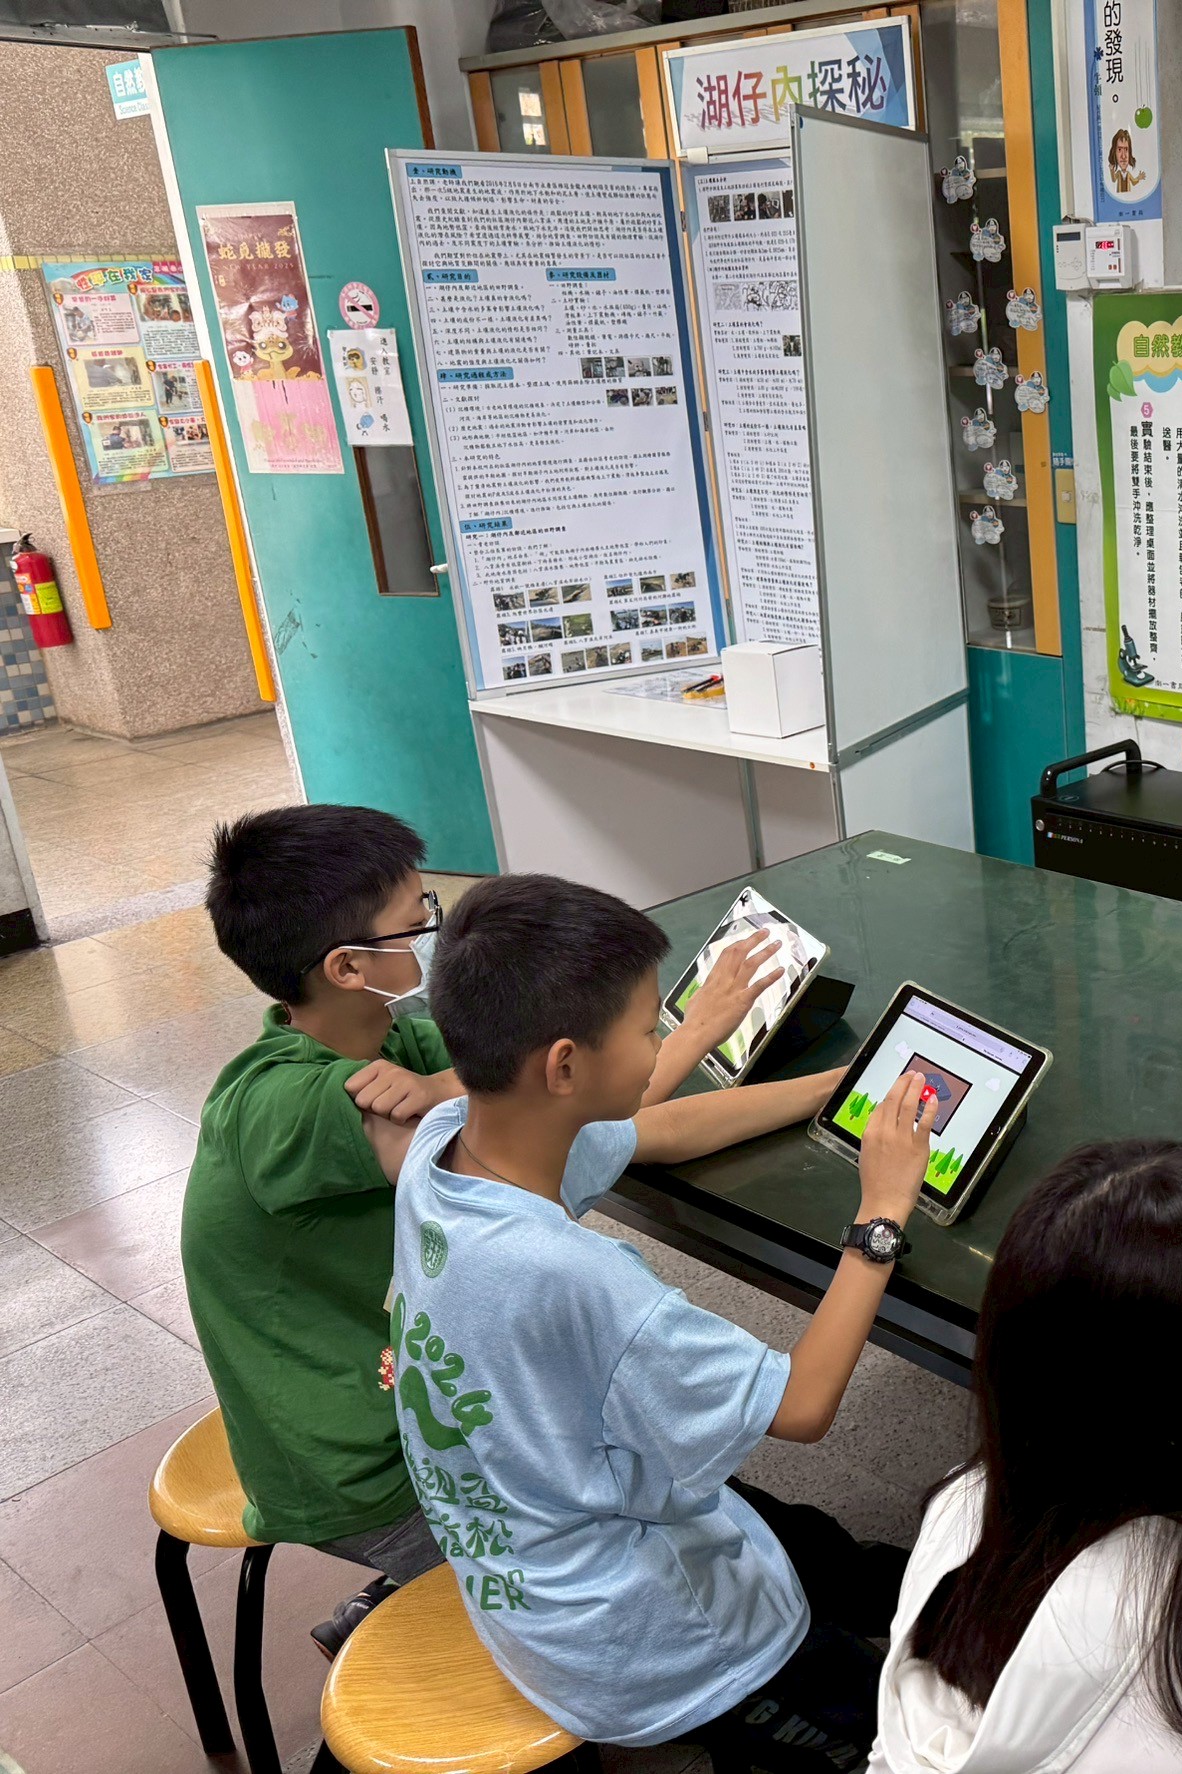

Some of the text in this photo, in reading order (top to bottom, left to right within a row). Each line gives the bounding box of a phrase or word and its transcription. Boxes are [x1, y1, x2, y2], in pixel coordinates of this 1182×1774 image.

[695, 54, 888, 130] 湖仔內探秘
[1162, 427, 1172, 462] 送醫。
